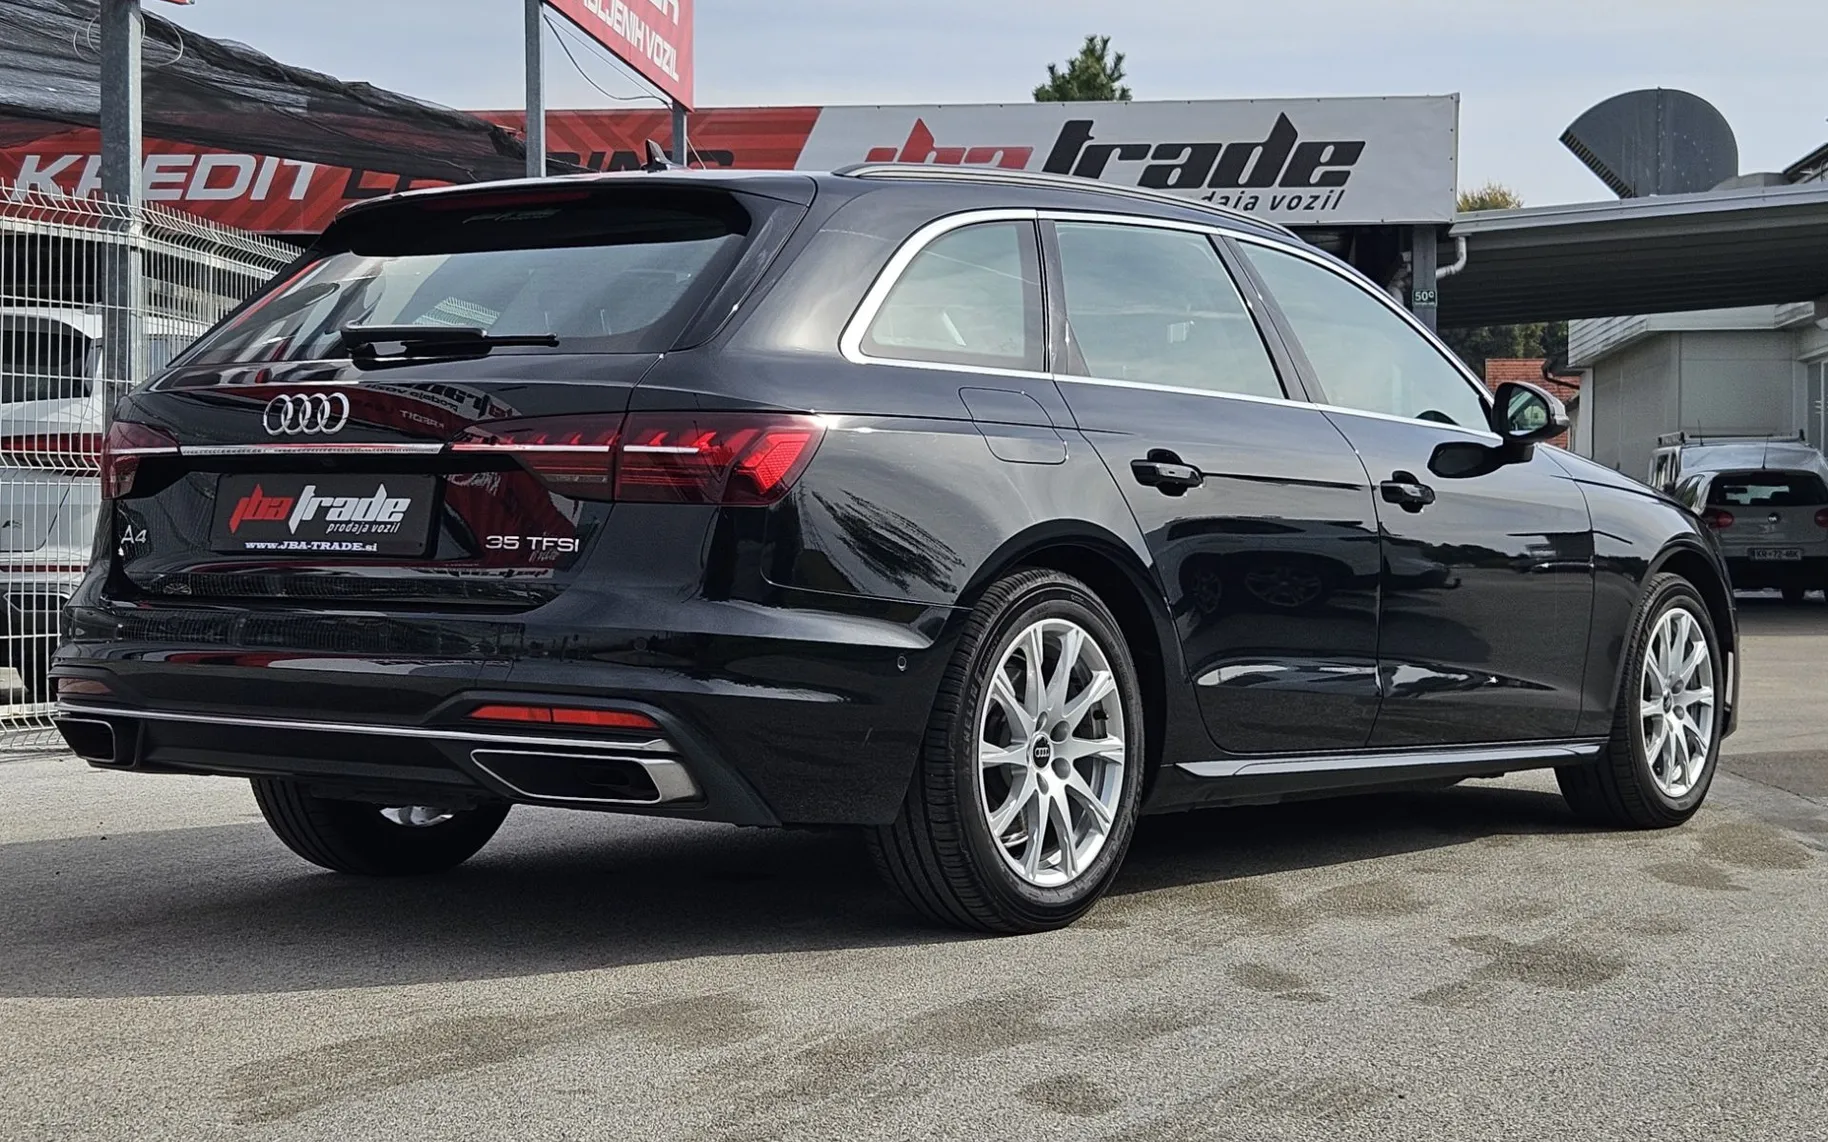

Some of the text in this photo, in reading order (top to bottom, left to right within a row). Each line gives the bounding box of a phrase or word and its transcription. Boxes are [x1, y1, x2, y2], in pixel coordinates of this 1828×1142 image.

[646, 24, 680, 83] VOZIL
[1269, 189, 1346, 211] vozil
[120, 524, 148, 545] A4
[326, 521, 401, 535] prodaja vozil
[245, 540, 378, 552] www.JBA-TRADE.si
[485, 535, 580, 553] 35 TFSI
